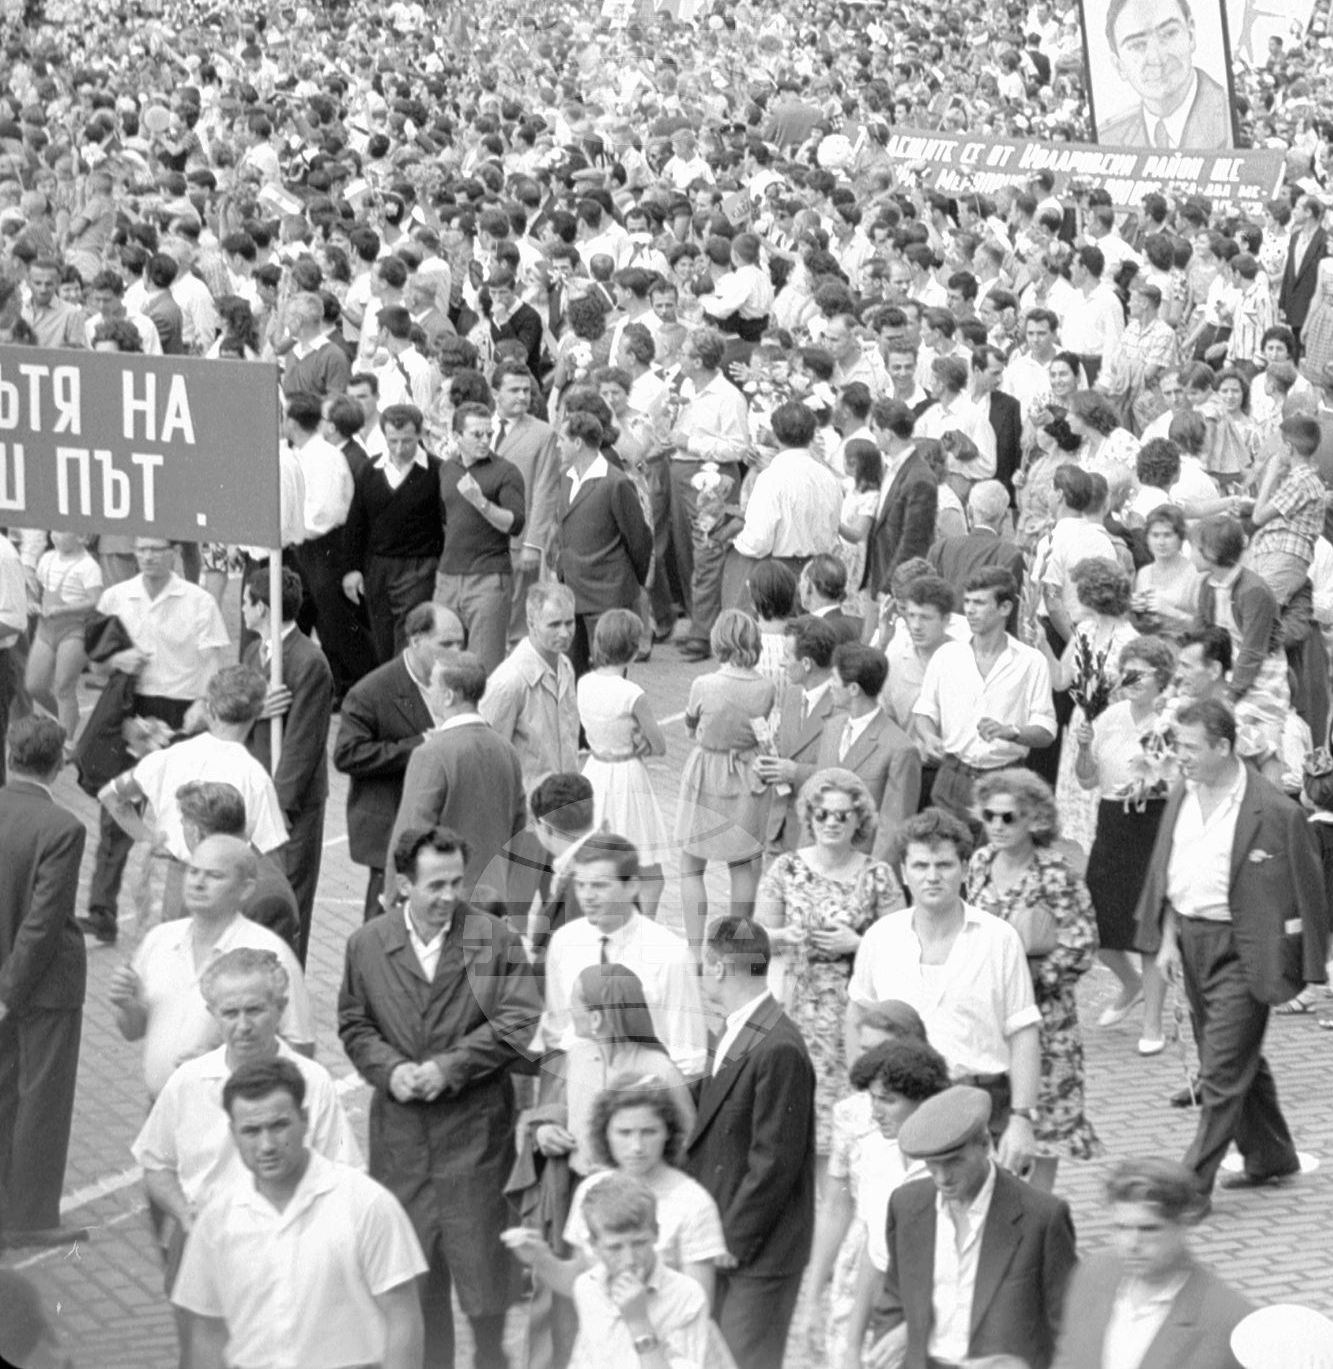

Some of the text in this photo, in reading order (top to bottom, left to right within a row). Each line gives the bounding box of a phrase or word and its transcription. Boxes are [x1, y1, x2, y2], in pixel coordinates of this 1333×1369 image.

[960, 142, 987, 164] СЕ
[986, 145, 1016, 167] ОТ
[1142, 152, 1205, 180] РАЙОН
[1209, 158, 1245, 182] ЩЕ
[122, 369, 196, 445] НА
